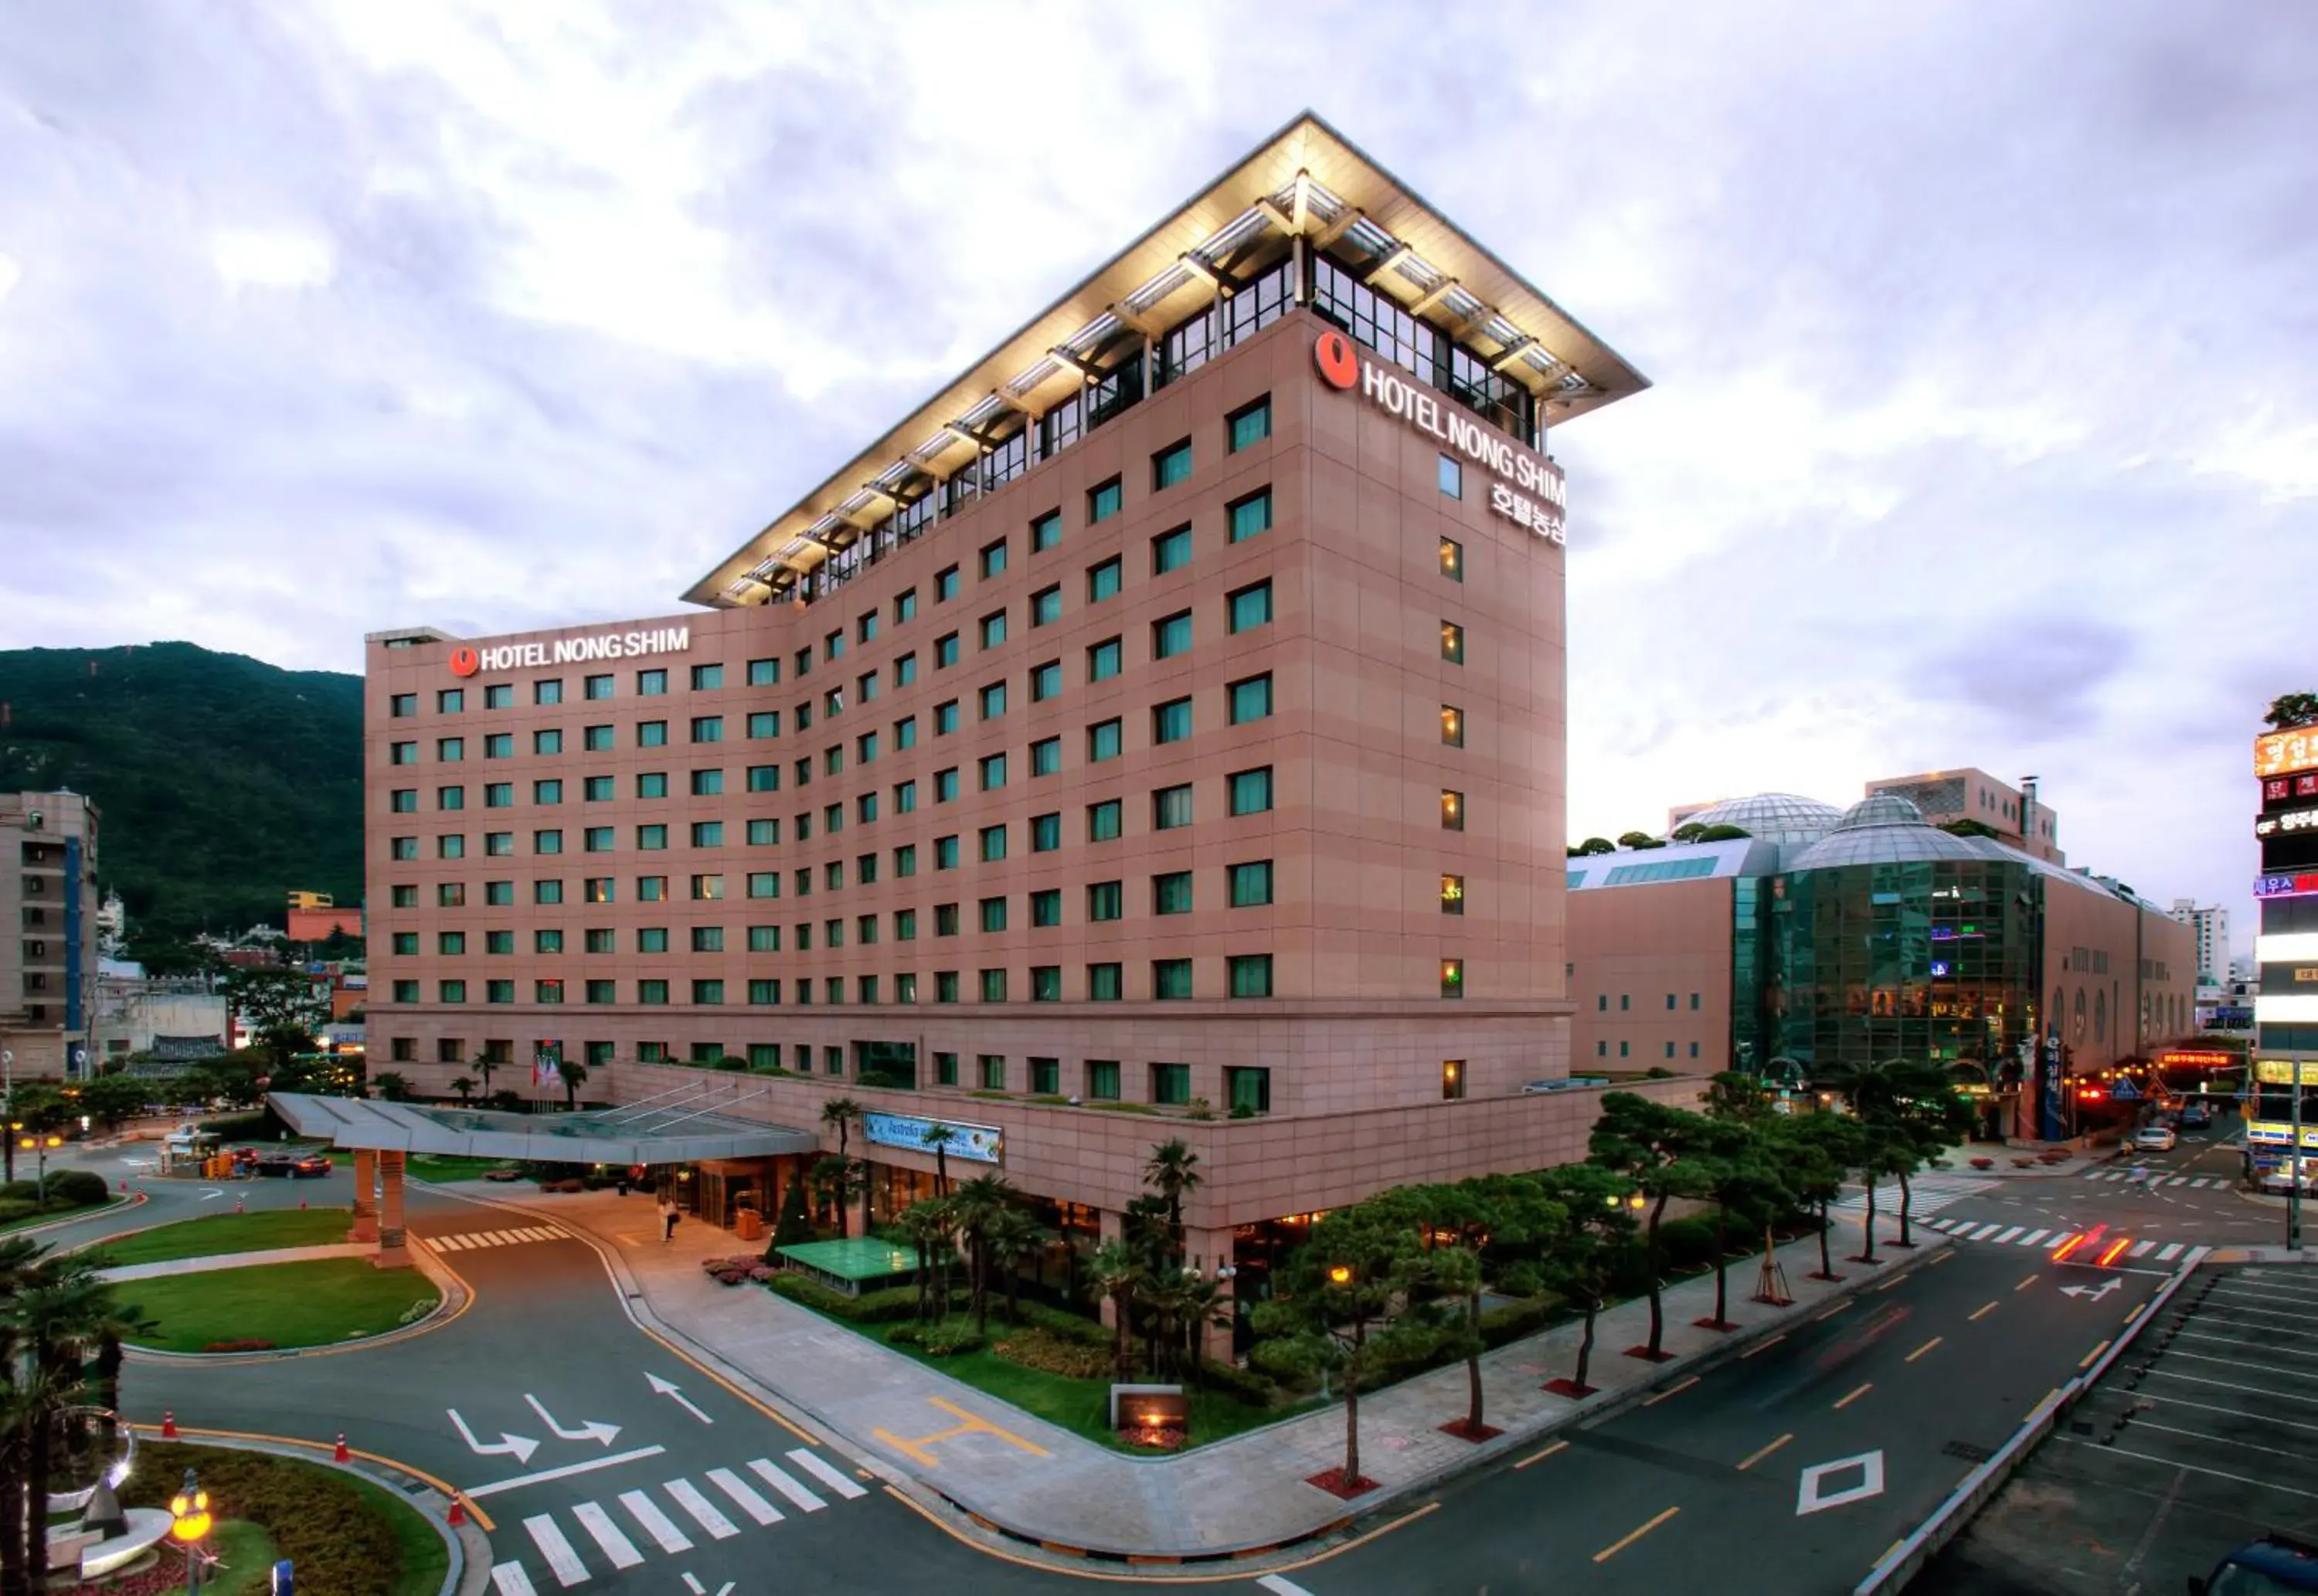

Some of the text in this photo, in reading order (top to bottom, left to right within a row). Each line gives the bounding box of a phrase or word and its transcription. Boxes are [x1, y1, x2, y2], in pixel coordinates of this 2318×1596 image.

[1363, 362, 1566, 508] HOTEL NONG SHIM
[481, 627, 690, 671] HOTEL NONG SHIM
